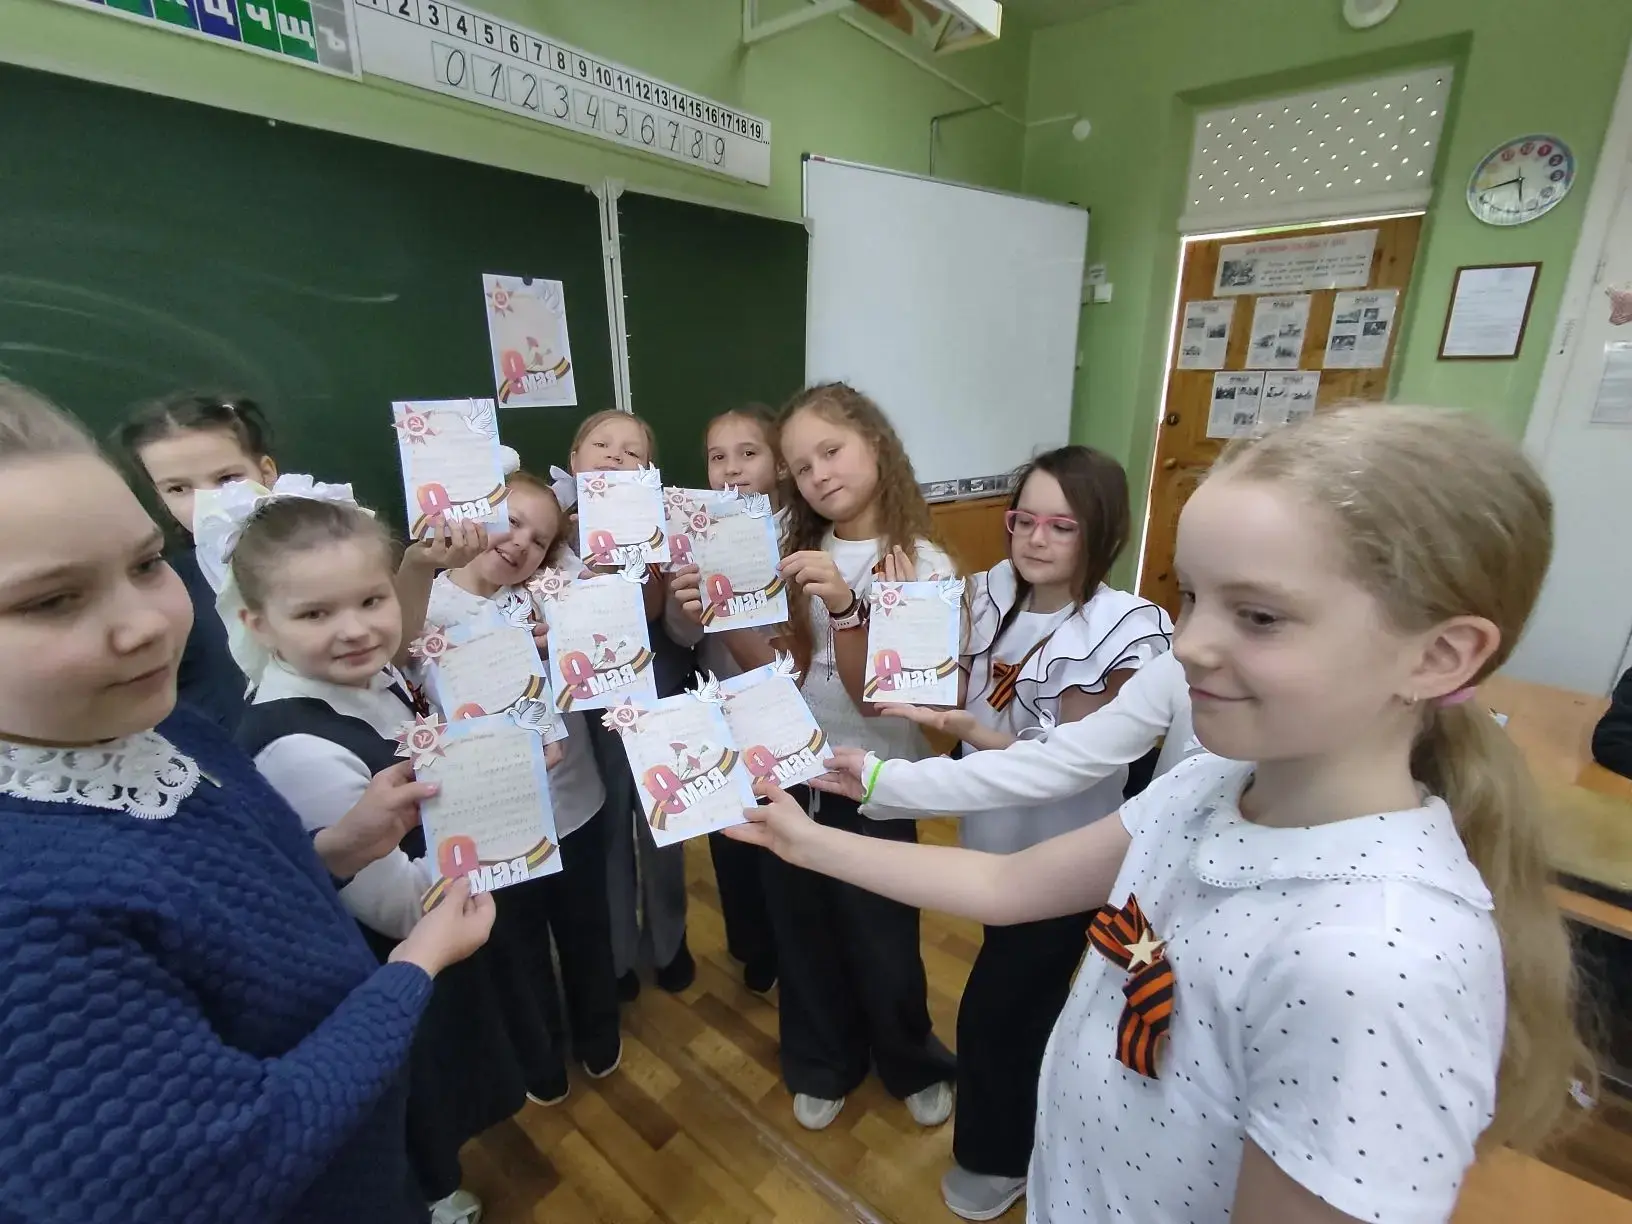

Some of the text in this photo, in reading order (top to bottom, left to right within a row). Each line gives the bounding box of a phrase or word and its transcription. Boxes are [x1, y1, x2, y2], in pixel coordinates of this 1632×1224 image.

[428, 4, 440, 26] 3
[456, 15, 468, 36] 4
[483, 24, 494, 45] 5
[509, 34, 519, 54] 6
[534, 42, 543, 61] 7
[557, 51, 566, 70] 8
[579, 60, 588, 78] 9
[596, 67, 612, 87] 10
[617, 75, 631, 94] 11
[636, 81, 650, 100] 12
[654, 88, 668, 107] 13
[672, 94, 686, 113] 14
[689, 99, 702, 118] 15
[705, 106, 718, 124] 16
[721, 112, 732, 129] 17
[735, 117, 747, 134] 18
[750, 122, 761, 139] 19
[446, 50, 725, 165] 0 1 2 3 4 5 6 7 8 9
[502, 349, 526, 394] 9
[588, 529, 615, 563] 9
[707, 573, 733, 617] 9
[559, 651, 595, 699] 9
[874, 649, 902, 691] 9
[643, 764, 687, 814] 9
